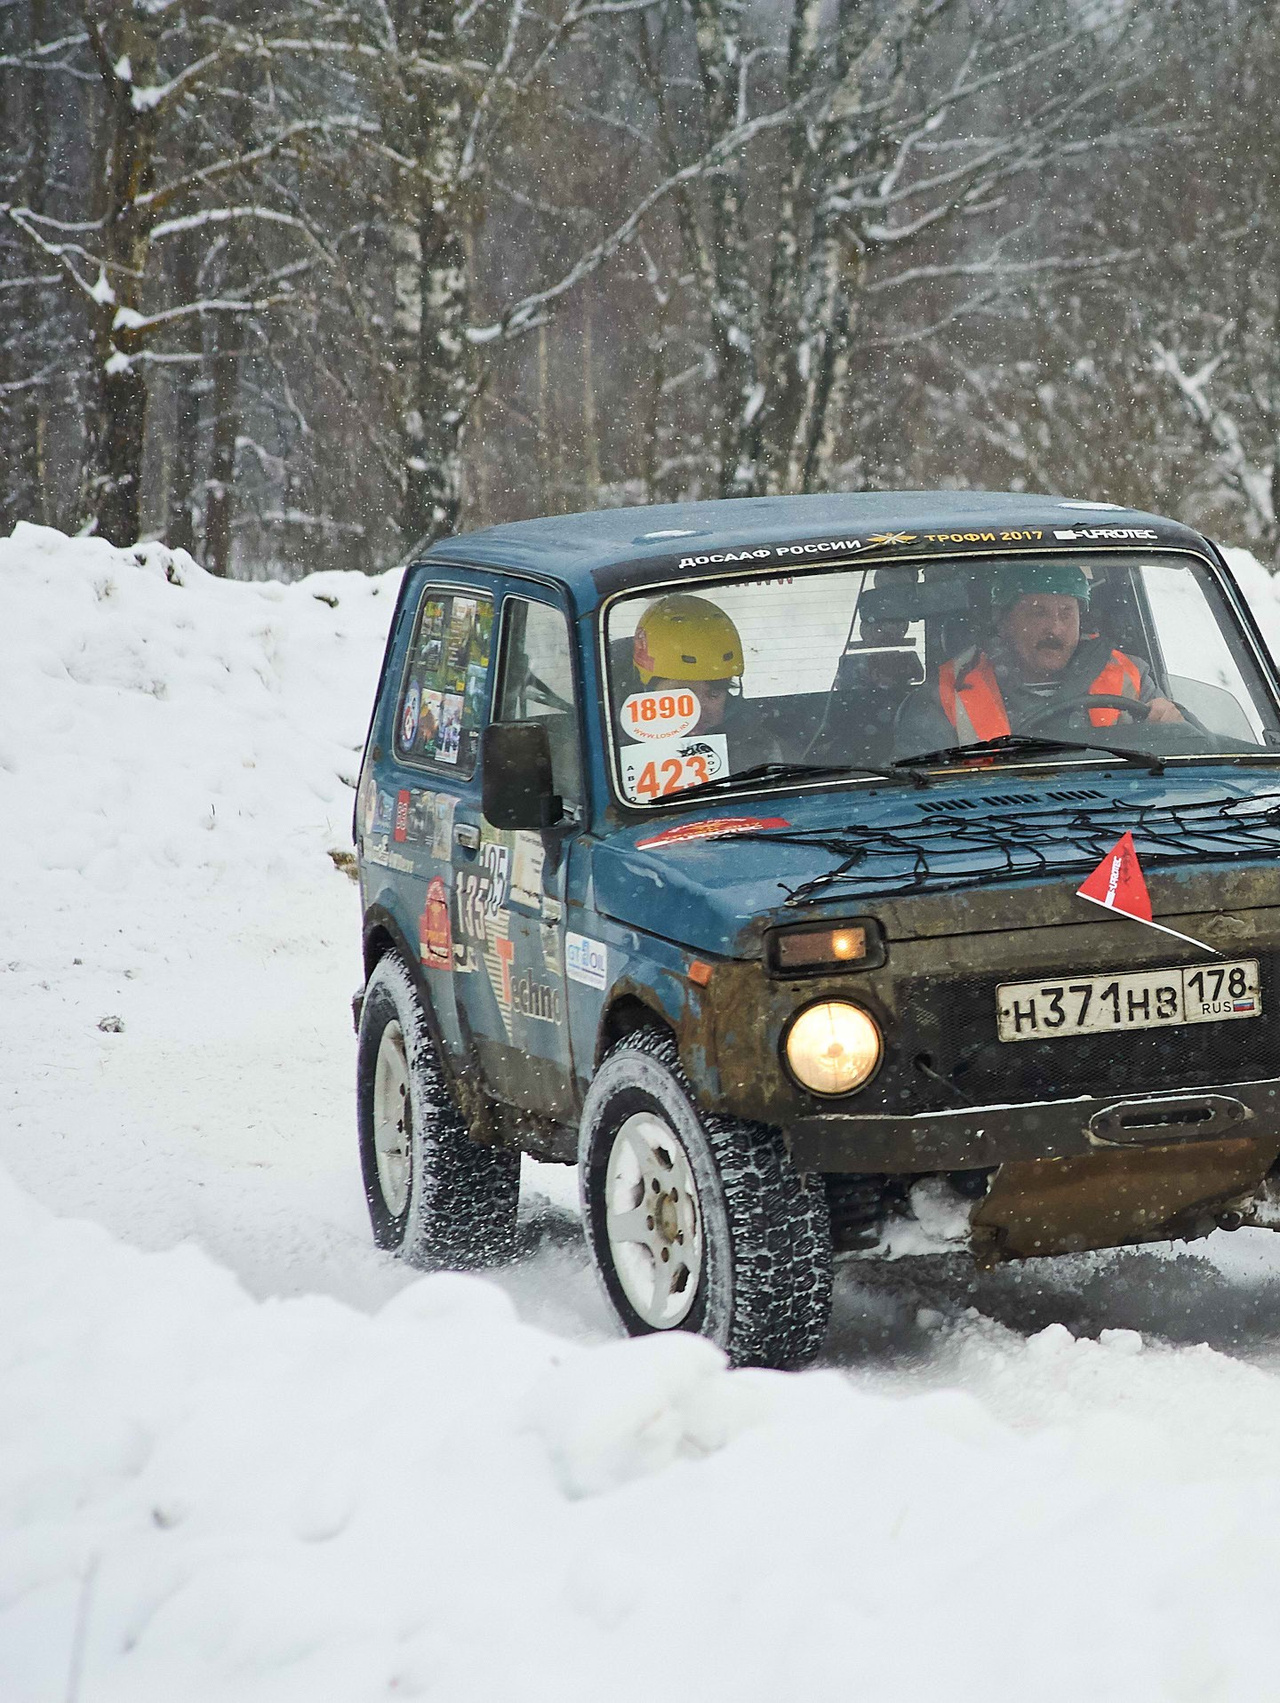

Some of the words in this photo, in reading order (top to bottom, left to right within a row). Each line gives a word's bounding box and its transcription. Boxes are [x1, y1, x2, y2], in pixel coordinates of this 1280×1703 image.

[678, 549, 771, 569] ДОСААФ
[776, 539, 862, 557] РОССИИ
[924, 531, 996, 543] ТРОФИ
[1000, 530, 1043, 542] 2017
[626, 694, 695, 723] 1890
[636, 755, 709, 798] 423
[1187, 967, 1247, 1003] 178
[1201, 1001, 1232, 1015] RUS
